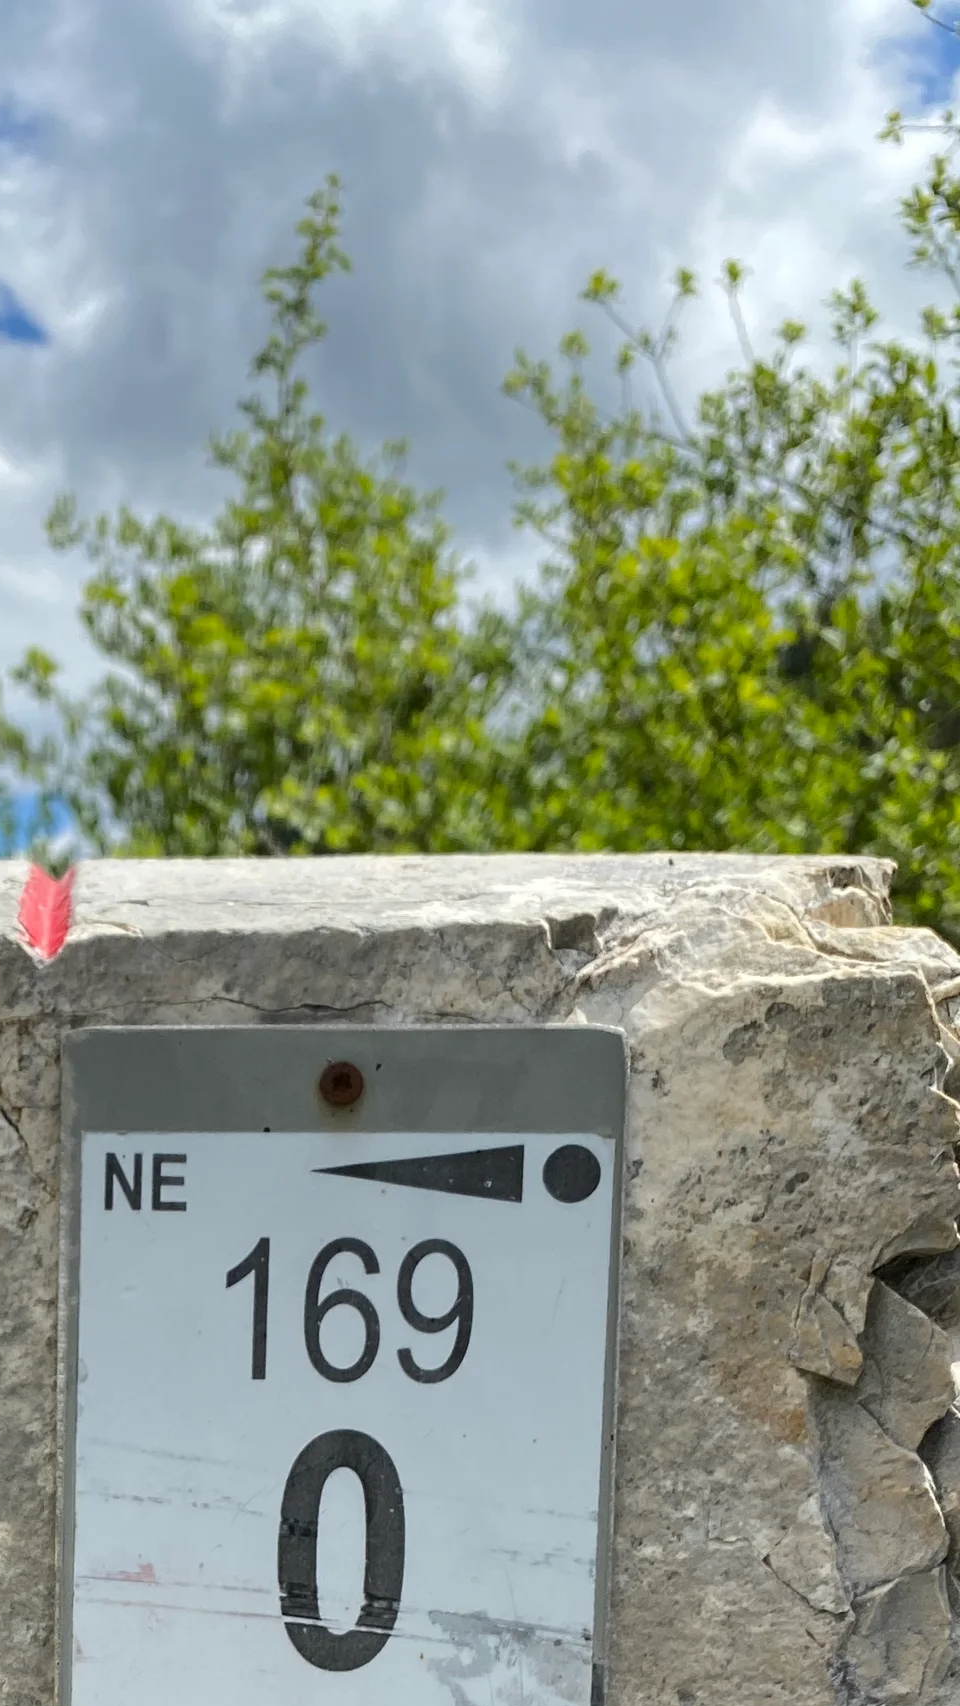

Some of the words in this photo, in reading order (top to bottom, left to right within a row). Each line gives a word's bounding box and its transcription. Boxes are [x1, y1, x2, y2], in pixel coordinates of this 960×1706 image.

[103, 1151, 189, 1213] NE
[224, 1235, 476, 1386] 169
[276, 1427, 407, 1673] 0
